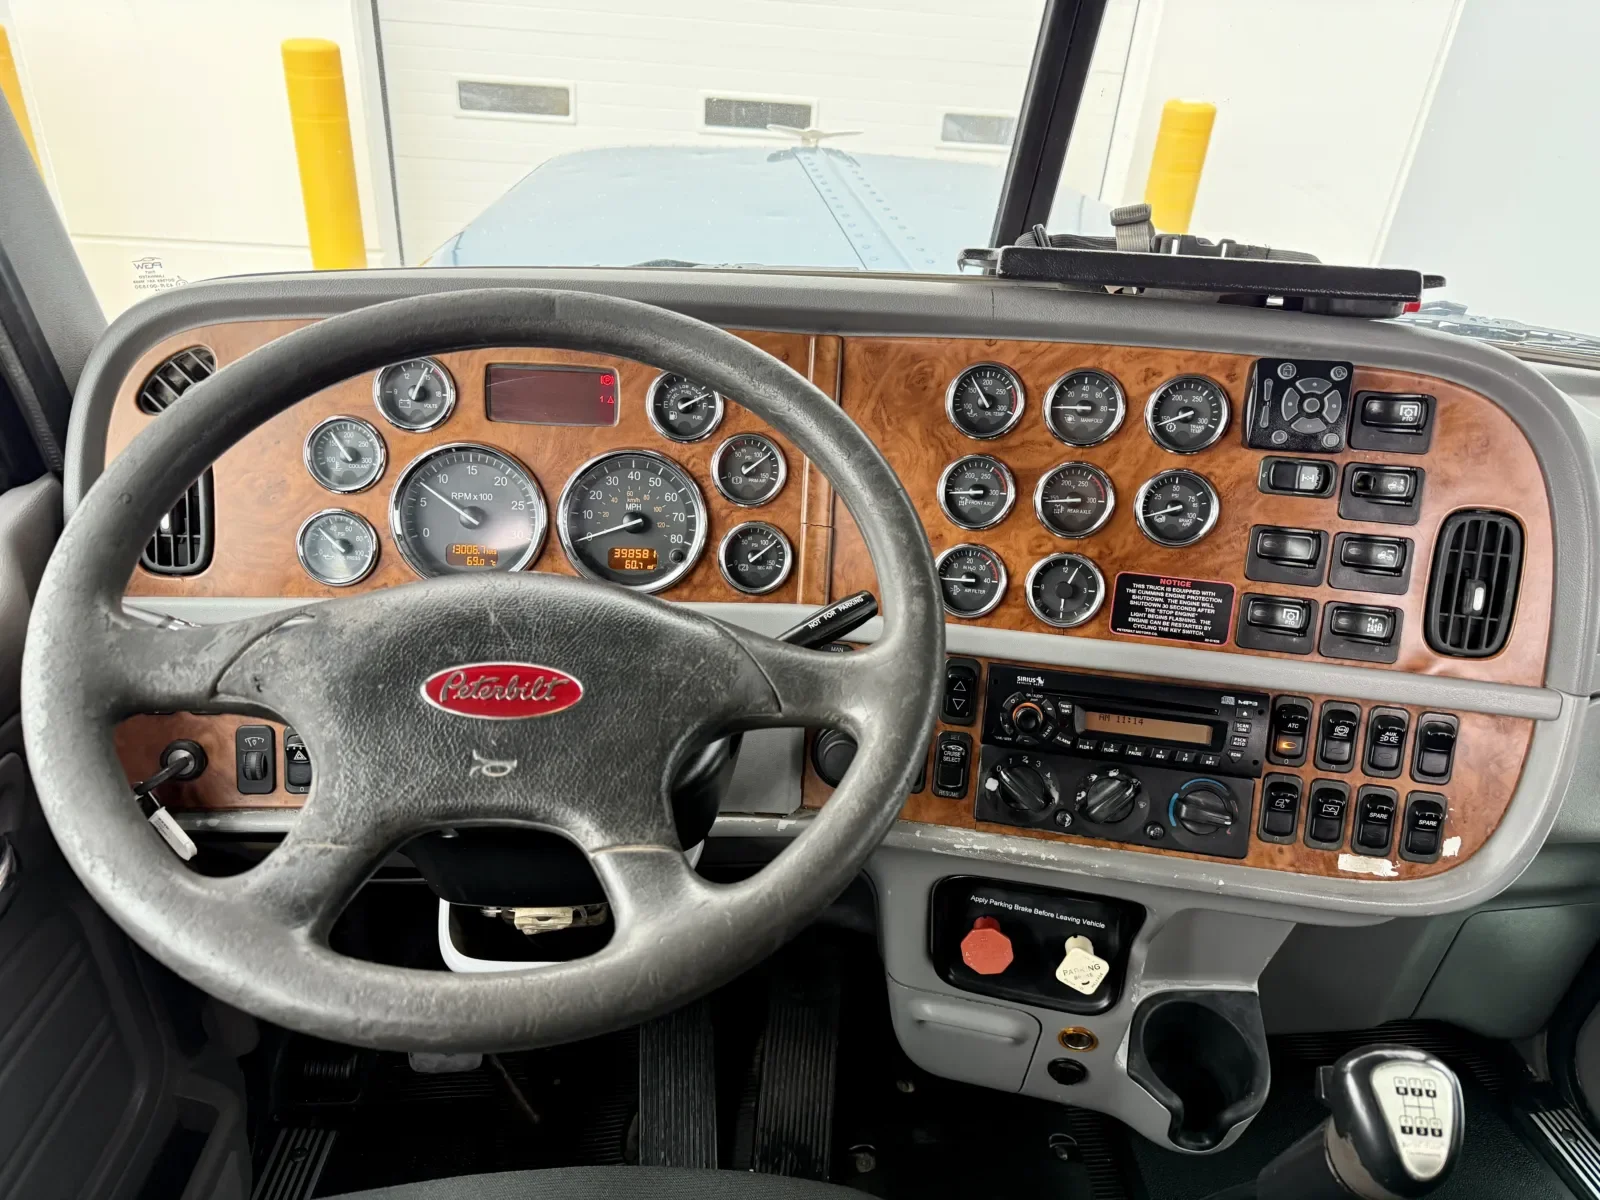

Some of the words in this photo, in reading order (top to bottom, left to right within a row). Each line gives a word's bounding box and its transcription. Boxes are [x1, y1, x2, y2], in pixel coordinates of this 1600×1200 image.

[466, 466, 478, 475] 15
[437, 475, 448, 484] 10
[628, 471, 640, 480] 40
[494, 477, 508, 486] 20
[606, 476, 618, 486] 30
[648, 477, 662, 487] 50
[451, 492, 471, 501] RPM
[590, 491, 602, 500] 20
[664, 493, 677, 502] 60
[420, 498, 427, 507] 5
[511, 501, 524, 510] 25
[583, 510, 593, 519] 10
[672, 513, 685, 522] 70
[423, 529, 430, 538] 0
[512, 530, 523, 539] 30
[670, 534, 683, 543] 80
[1160, 578, 1191, 587] NOTICE
[1187, 595, 1222, 603] PROTECTION
[807, 619, 821, 629] NOT
[823, 610, 836, 620] FOR
[838, 596, 864, 612] PARKING
[1171, 622, 1203, 630] RESTARTED
[440, 670, 570, 702] Peterbilt
[1116, 716, 1144, 725] 11:14
[1056, 736, 1071, 745] ALARM
[970, 895, 988, 905] Apply
[989, 899, 1013, 910] Parking
[1014, 904, 1032, 913] Brake
[1034, 908, 1054, 918] Before
[1056, 913, 1080, 924] Leaving
[1082, 919, 1105, 929] Vehicle
